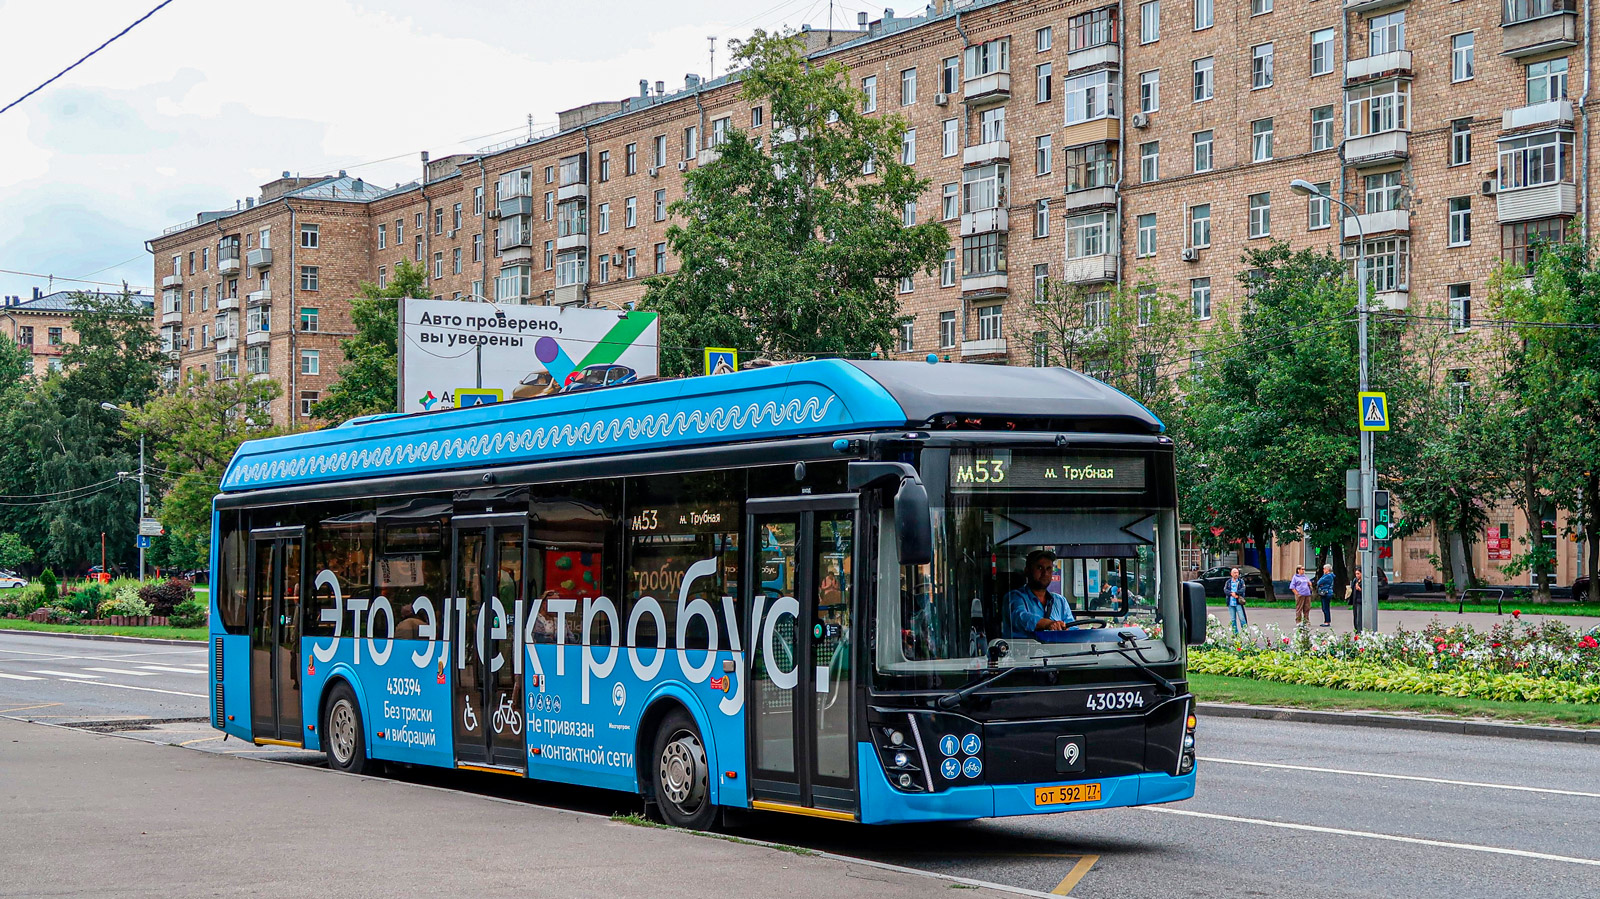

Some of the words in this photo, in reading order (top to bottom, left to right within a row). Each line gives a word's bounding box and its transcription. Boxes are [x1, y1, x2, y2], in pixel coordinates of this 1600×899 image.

[420, 311, 462, 326] Авто
[466, 316, 563, 334] проверено,
[420, 332, 443, 343] вы
[448, 333, 523, 347] уверены
[1063, 464, 1114, 480] Трубная
[690, 510, 720, 525] Трубная
[1380, 509, 1388, 522] 15
[1378, 546, 1392, 558] 24
[312, 569, 395, 666] Это
[387, 677, 421, 696] 430394
[1086, 691, 1144, 710] 430394
[384, 700, 400, 719] Без
[401, 707, 433, 724] тряски
[527, 713, 541, 732] Не
[544, 719, 595, 738] привязан
[385, 728, 390, 740] и
[392, 725, 436, 748] вибраций
[540, 744, 605, 765] контактной
[607, 751, 633, 768] сети
[1060, 787, 1080, 801] 592
[1086, 784, 1097, 796] 77
